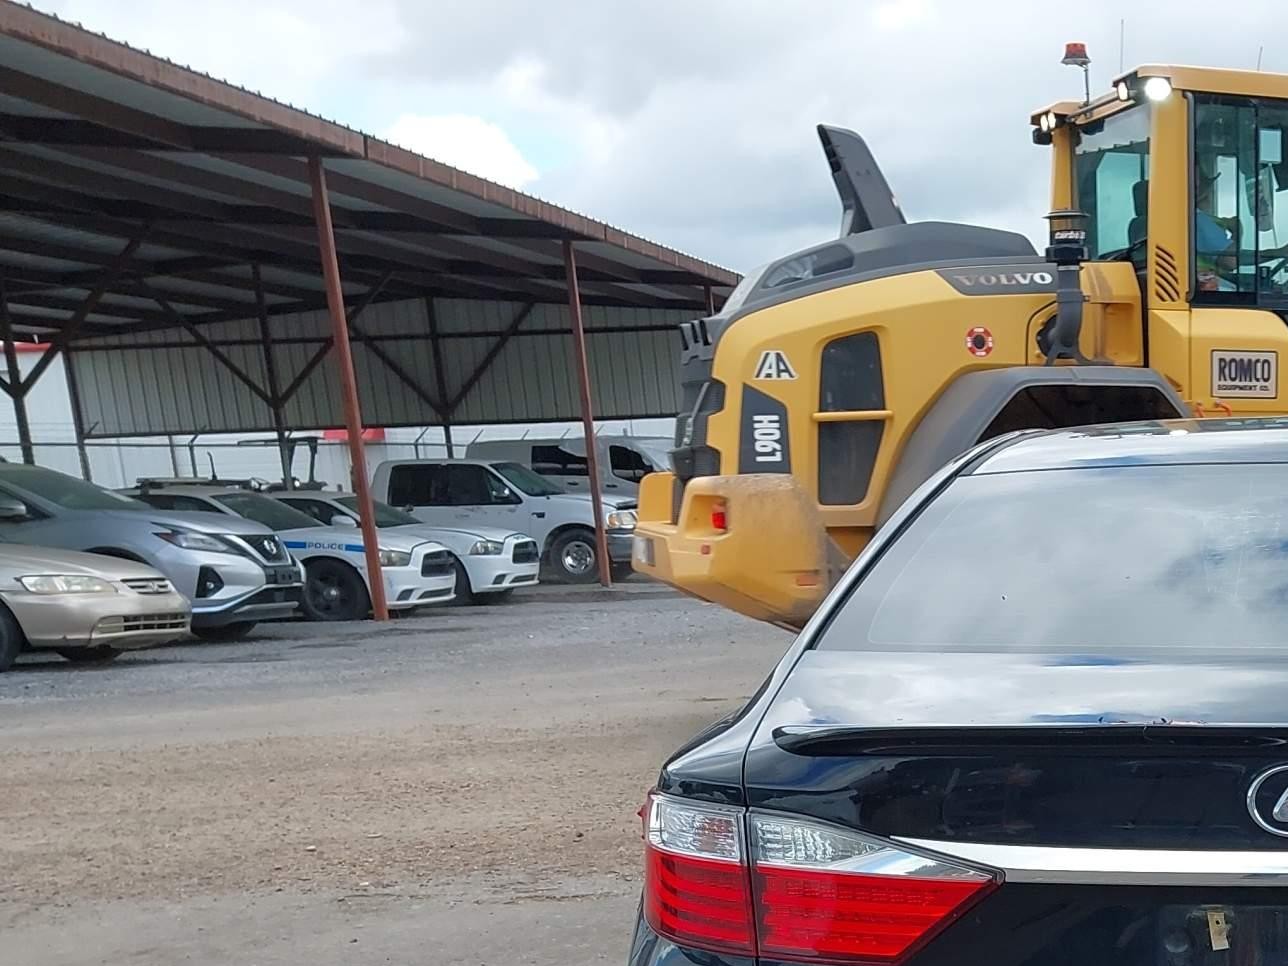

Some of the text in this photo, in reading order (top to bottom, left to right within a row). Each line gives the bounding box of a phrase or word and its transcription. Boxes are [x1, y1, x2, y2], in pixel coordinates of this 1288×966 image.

[954, 272, 1053, 286] VOLVO
[1218, 358, 1271, 382] ROMCO
[752, 414, 783, 462] L90H
[307, 542, 344, 550] POLICE
